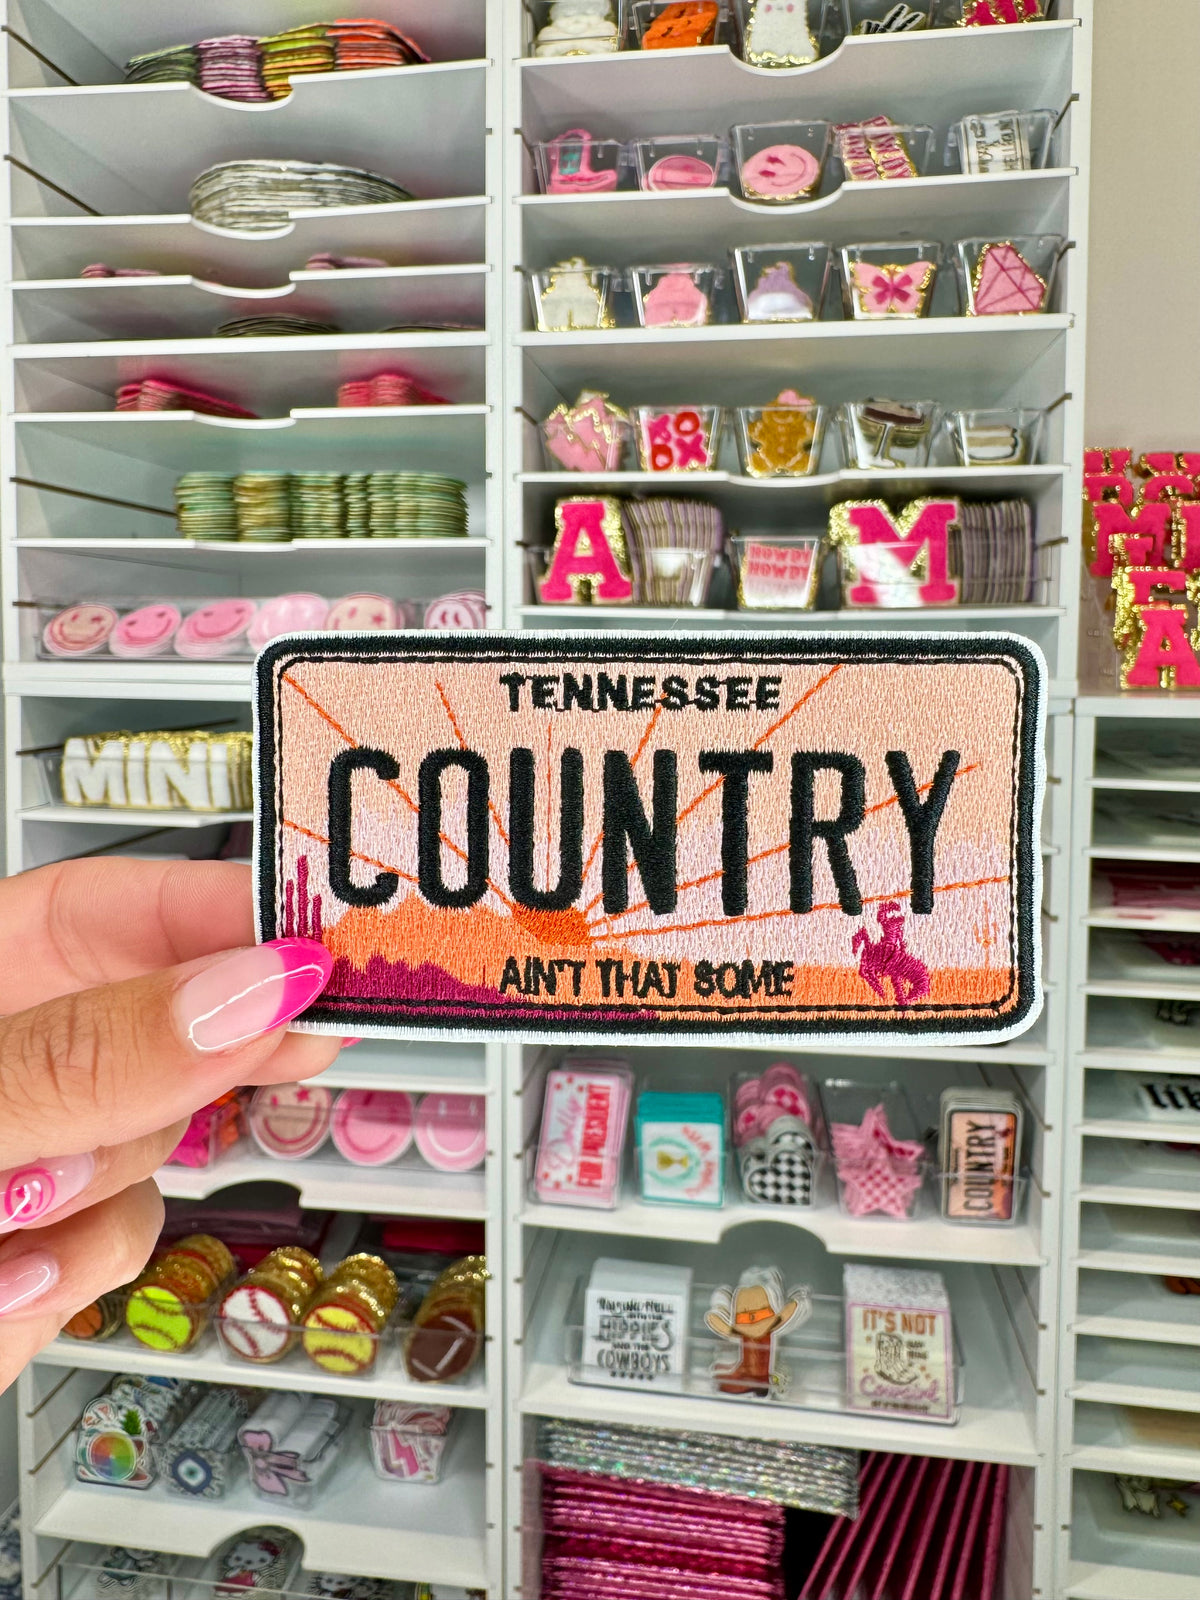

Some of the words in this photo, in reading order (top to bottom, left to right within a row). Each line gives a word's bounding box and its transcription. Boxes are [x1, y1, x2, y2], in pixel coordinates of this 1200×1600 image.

[541, 501, 632, 602] A
[500, 671, 782, 712] TENNESSEE
[63, 737, 233, 810] MINI
[328, 745, 961, 916] COUNTRY
[500, 955, 585, 997] AIN'T
[595, 958, 681, 999] THAT
[694, 959, 795, 999] SOME
[962, 1119, 996, 1211] COUNTRY
[862, 1310, 896, 1333] IT'S
[902, 1313, 936, 1336] NOT
[597, 1349, 672, 1373] COWBOYS
